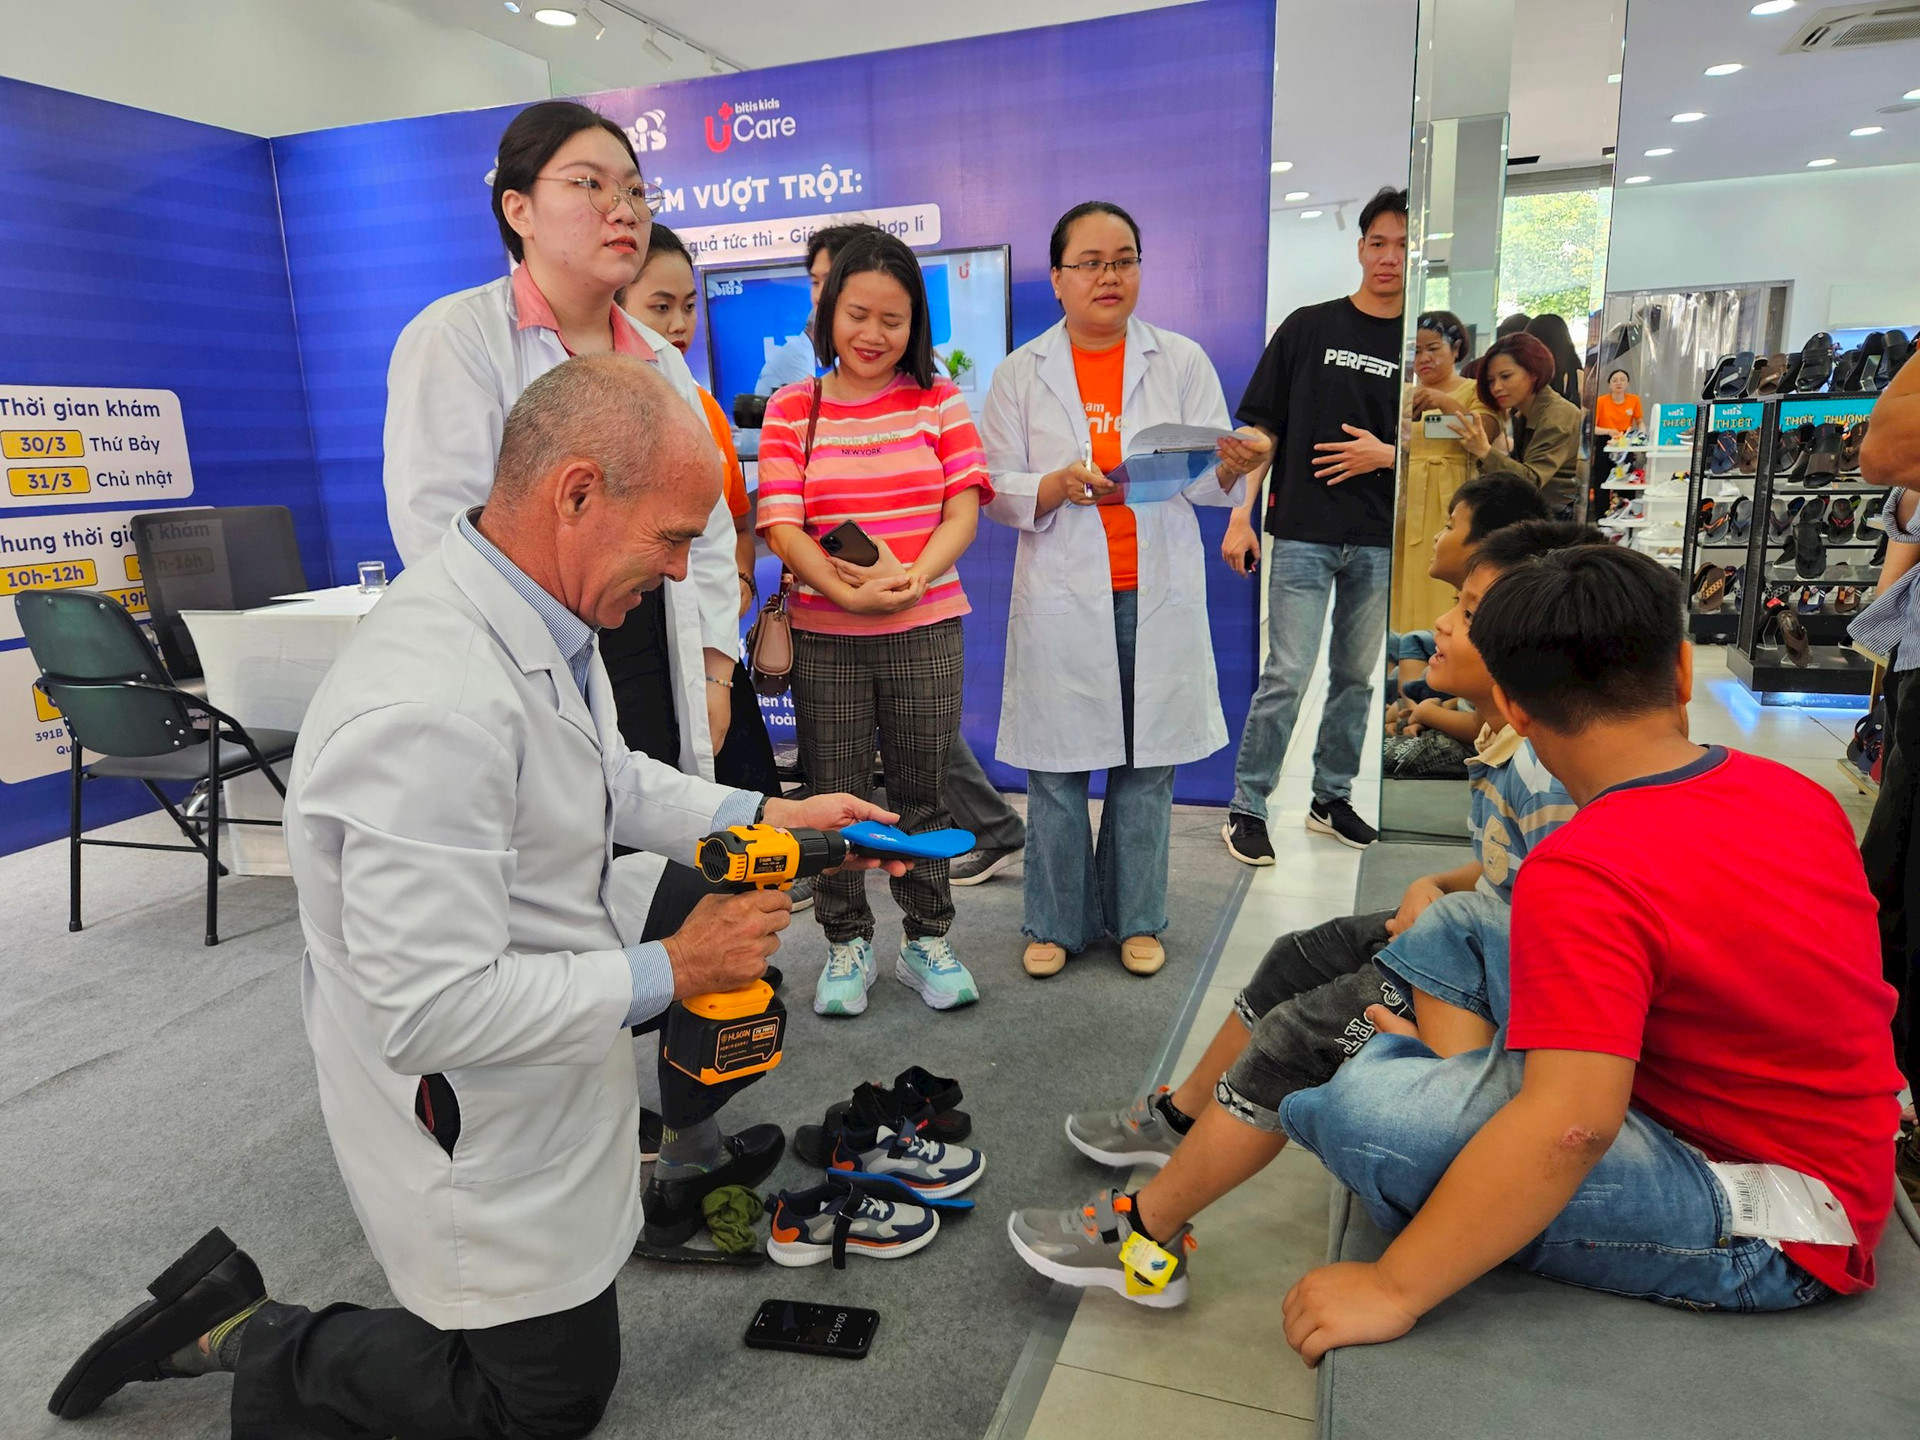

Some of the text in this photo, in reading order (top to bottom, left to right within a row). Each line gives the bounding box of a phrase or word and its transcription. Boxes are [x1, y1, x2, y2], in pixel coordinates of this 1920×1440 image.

[758, 98, 780, 111] kids
[693, 176, 769, 213] VƯỢT
[779, 163, 863, 203] TRỘI:
[723, 232, 748, 250] tức
[752, 230, 773, 247] thì
[915, 215, 924, 232] lí
[0, 396, 160, 421] Thời gian khám
[20, 435, 160, 455] 30/3 Thứ Bảy
[27, 470, 173, 491] 31/3 Chủ nhật
[0, 535, 56, 554] hung
[63, 527, 103, 547] thời
[7, 565, 84, 587] 10h-12h
[35, 728, 63, 742] 391B
